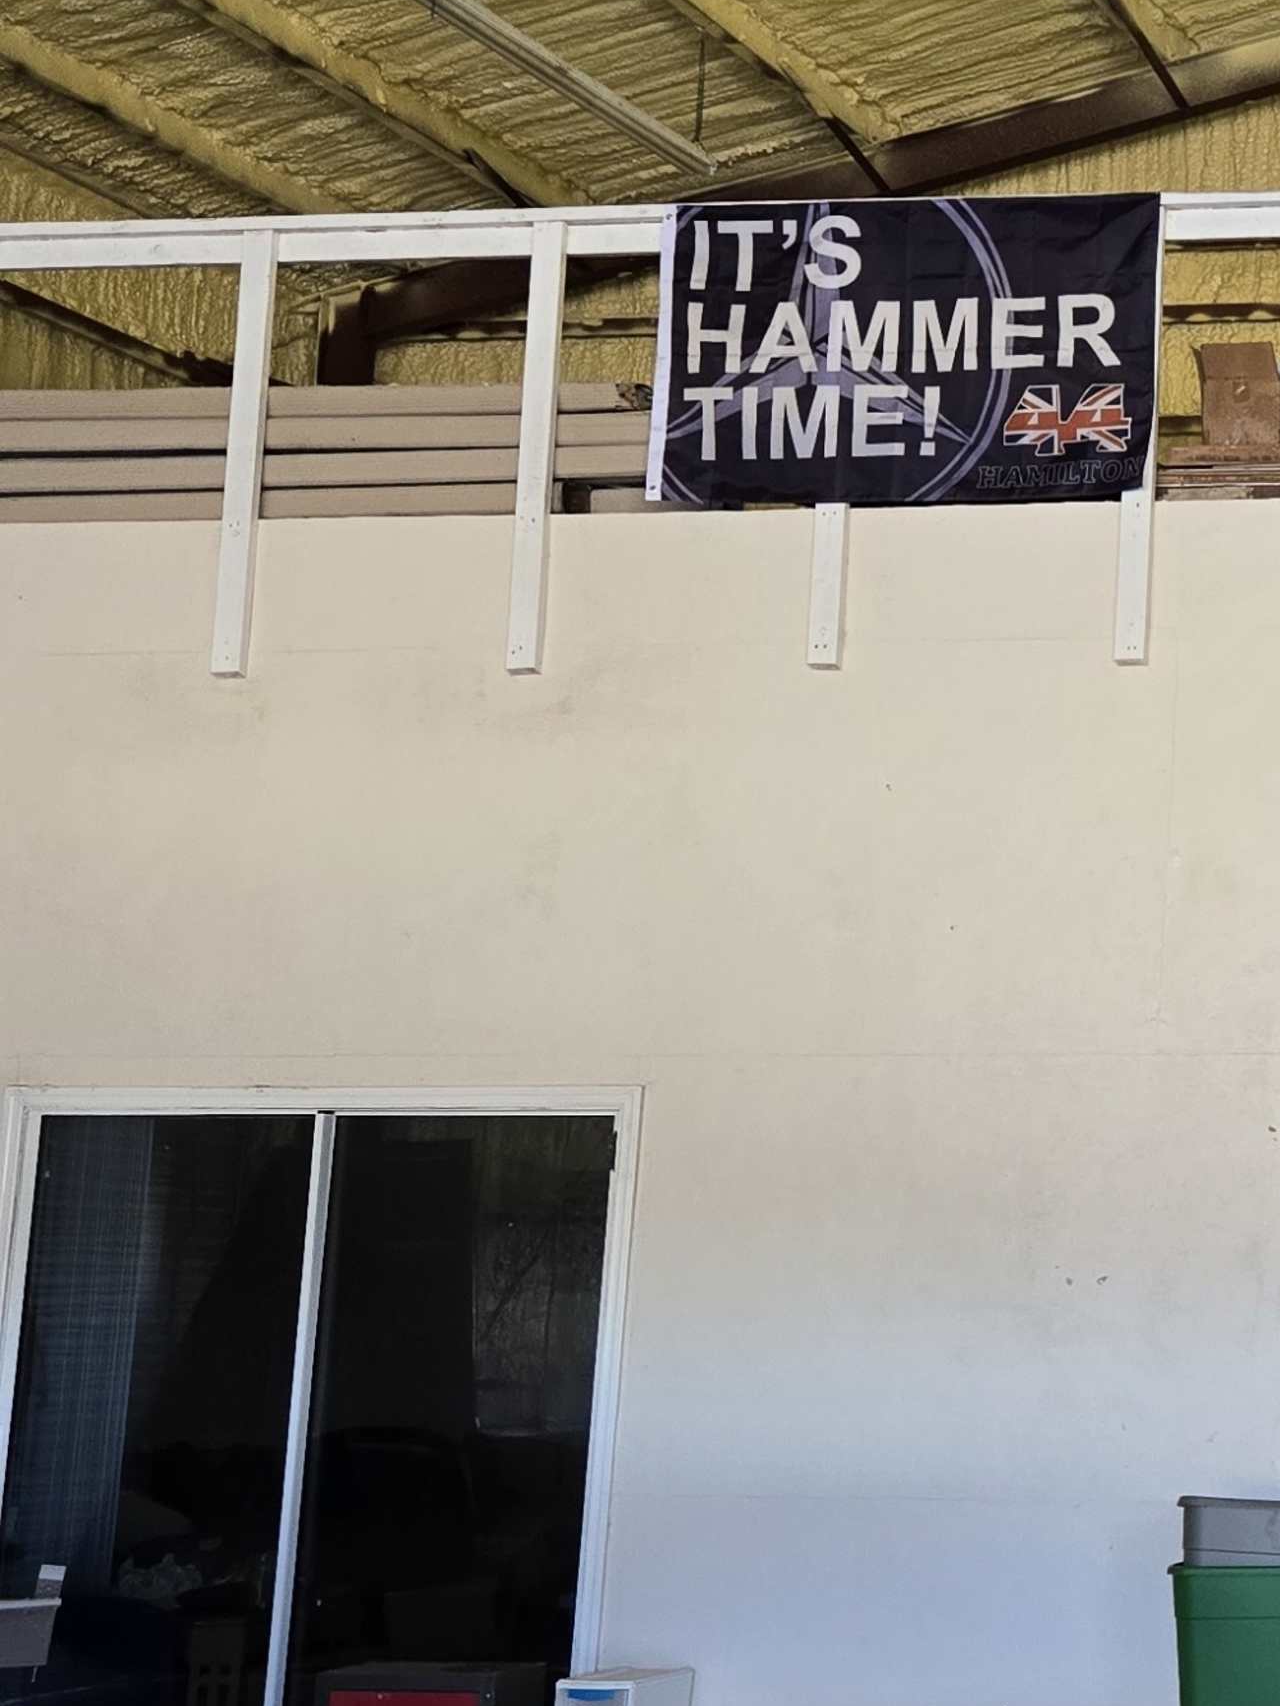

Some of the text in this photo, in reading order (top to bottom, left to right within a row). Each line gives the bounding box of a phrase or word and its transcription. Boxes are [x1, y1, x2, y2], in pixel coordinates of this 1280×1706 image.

[690, 215, 863, 292] IT'S
[686, 294, 1121, 374] HAMMER
[683, 385, 937, 461] TIME!
[1003, 383, 1132, 456] 44
[976, 457, 1144, 489] HAMILTON
